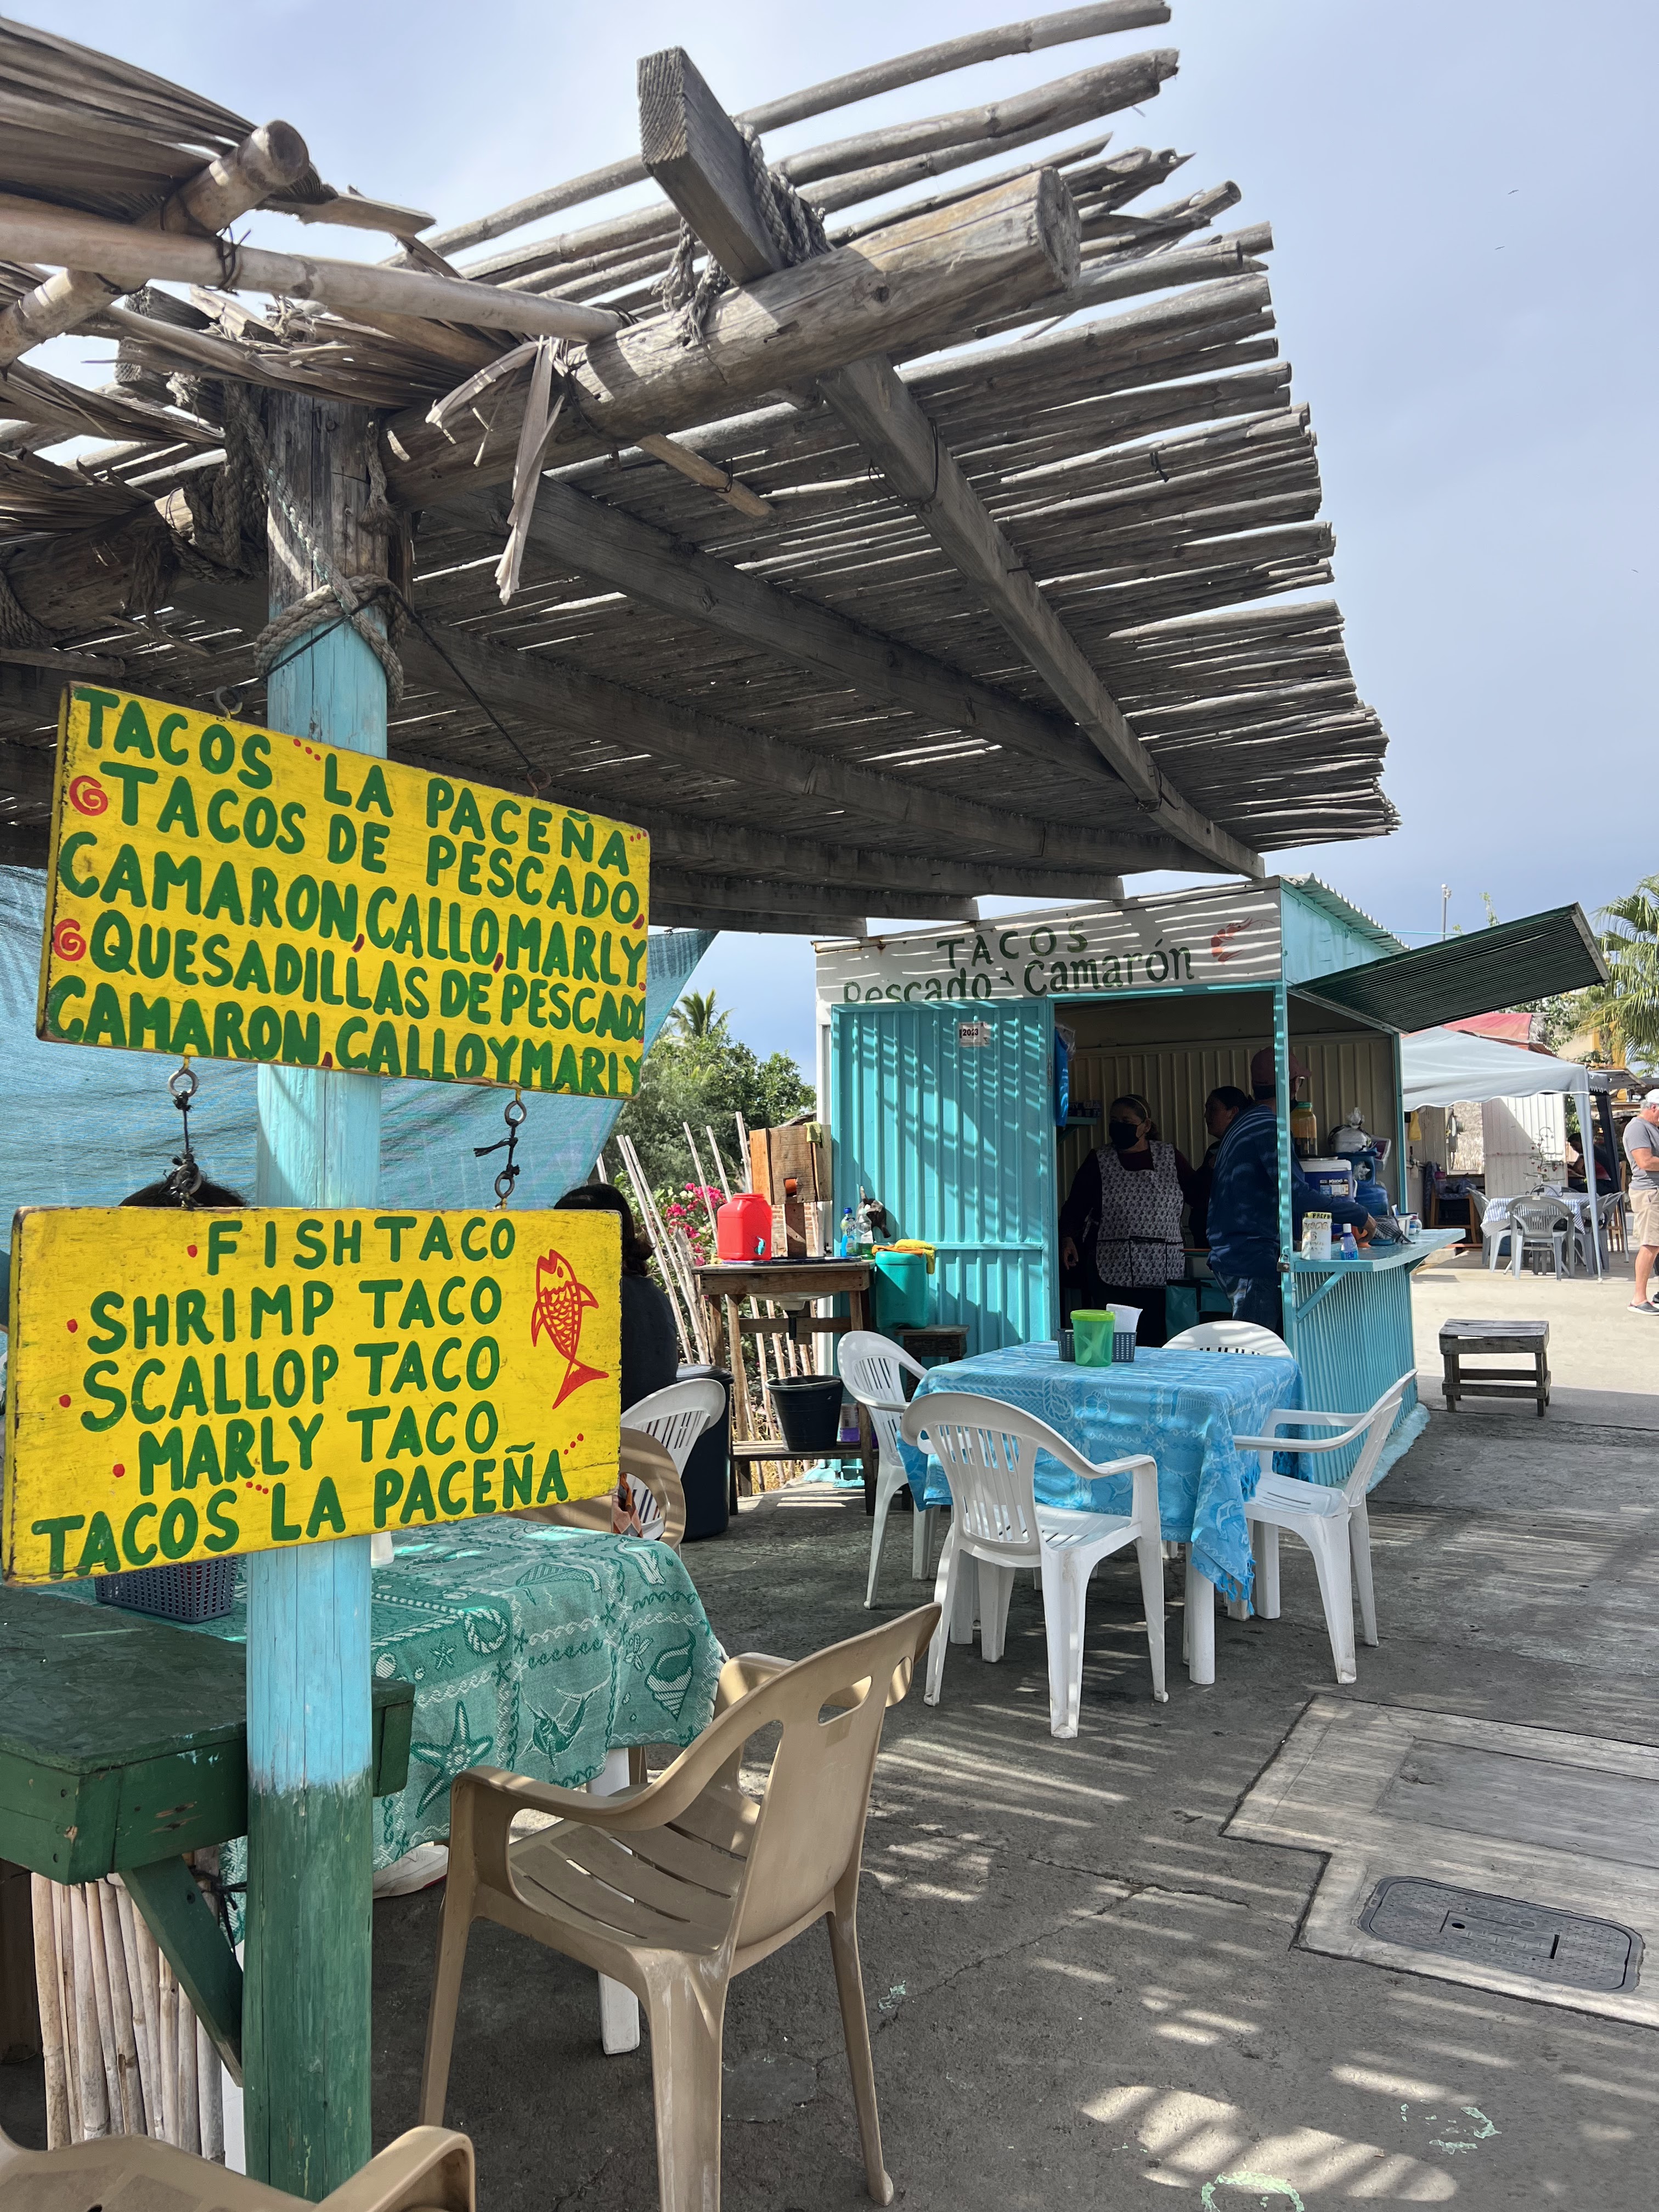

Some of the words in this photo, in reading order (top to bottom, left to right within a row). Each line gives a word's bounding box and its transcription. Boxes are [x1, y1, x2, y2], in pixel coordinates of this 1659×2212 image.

[73, 686, 272, 789] TACOS
[325, 753, 394, 817] LA
[427, 778, 629, 876] PACEÑA
[100, 761, 306, 855] TACOS
[328, 813, 391, 874] DE
[91, 909, 430, 1020] QUESADILLAS
[440, 969, 493, 1025] DE
[936, 921, 1088, 969] TACOS
[1024, 938, 1194, 996] Camarón
[962, 1028, 979, 1036] 2023
[208, 1219, 361, 1276] FISH
[374, 1216, 515, 1262] TACO
[88, 1279, 334, 1355] SHRIMP
[358, 1276, 502, 1329] TACO
[81, 1343, 340, 1432] SCALLOP
[354, 1335, 500, 1396] TACO
[139, 1412, 324, 1496] MARLY
[347, 1400, 498, 1463] TACO
[31, 1488, 240, 1580] TACOS
[271, 1476, 346, 1541] LA
[374, 1440, 569, 1528] PACEÑA
